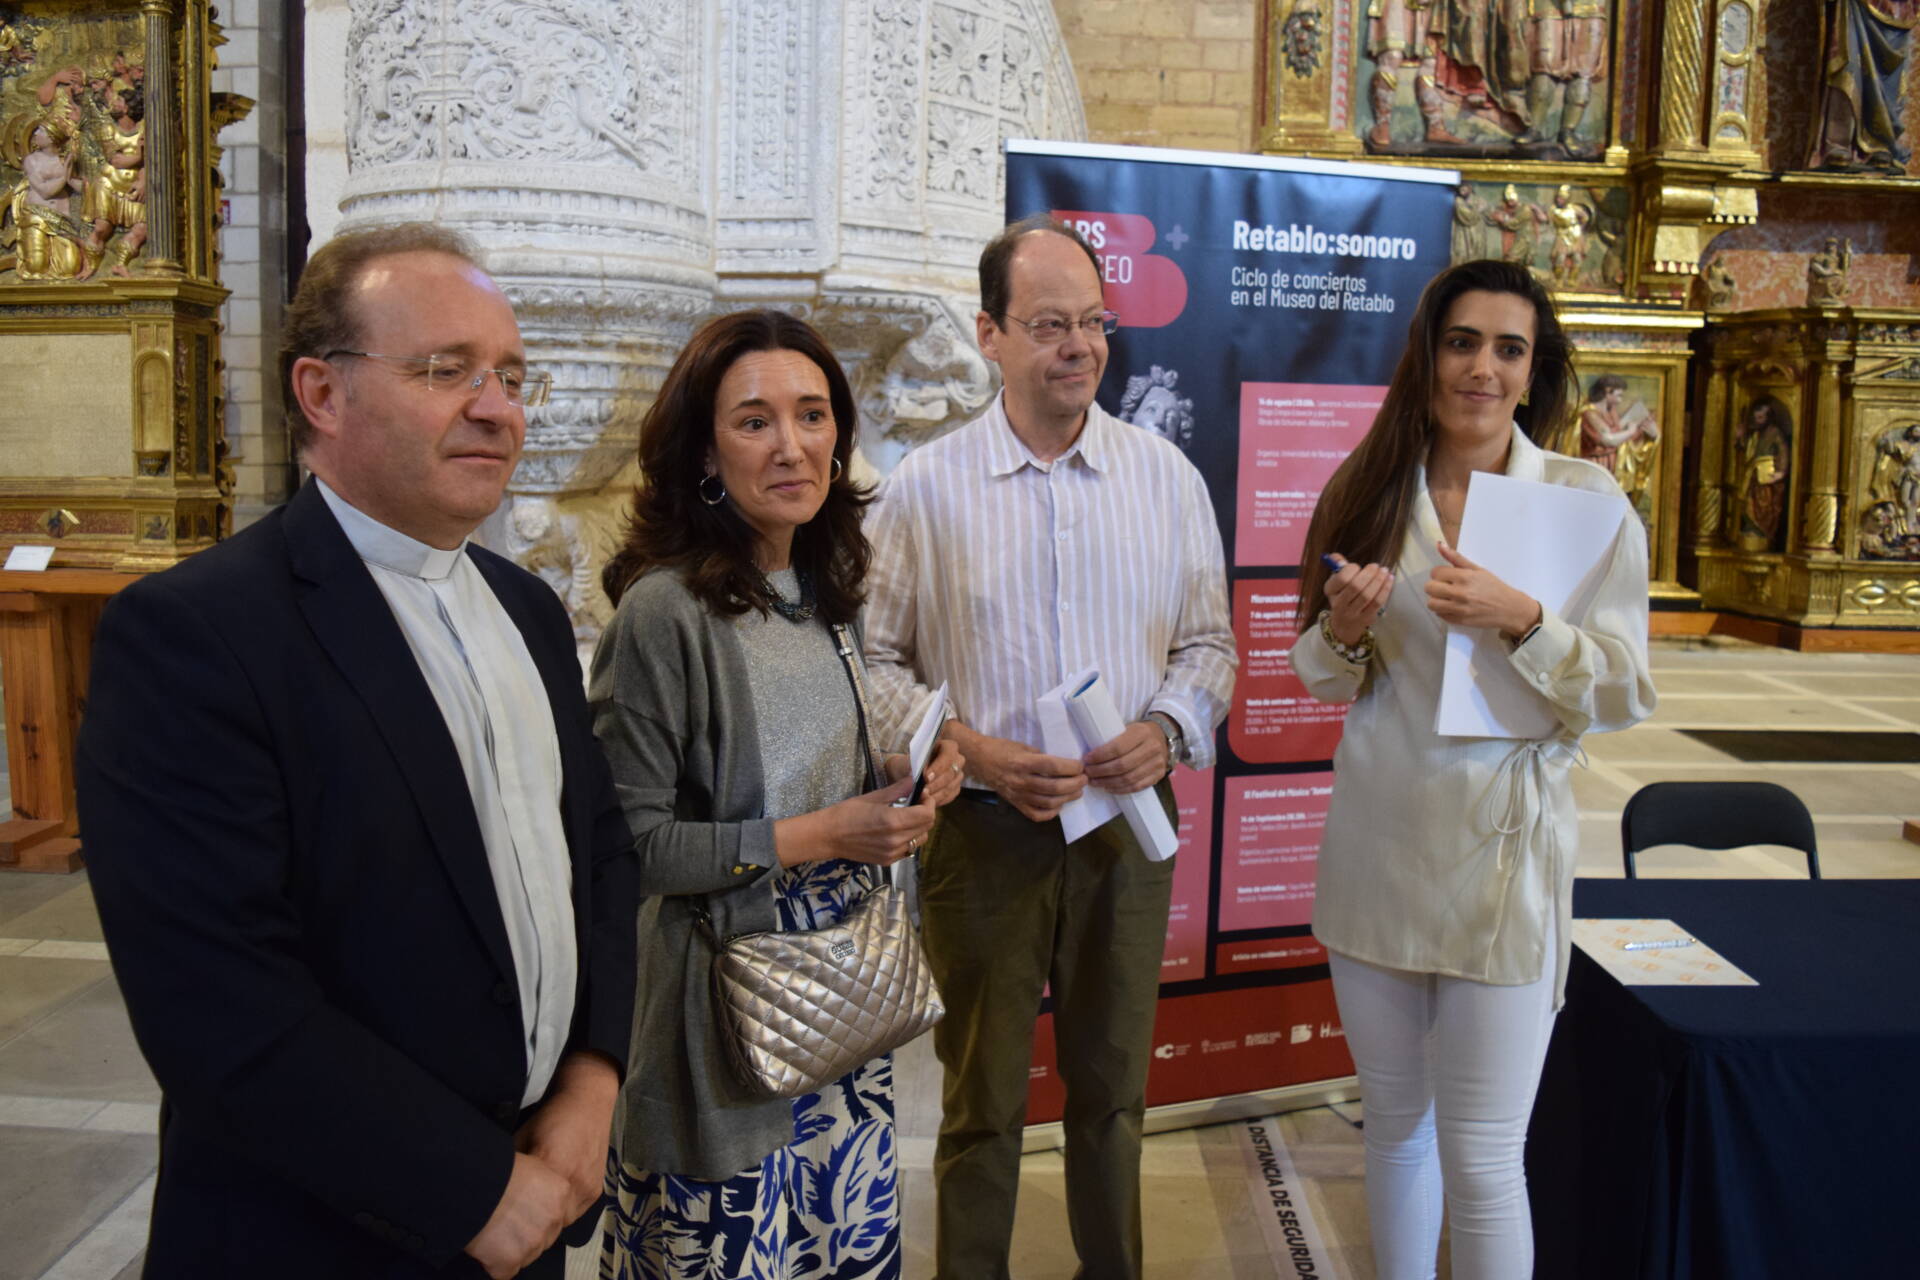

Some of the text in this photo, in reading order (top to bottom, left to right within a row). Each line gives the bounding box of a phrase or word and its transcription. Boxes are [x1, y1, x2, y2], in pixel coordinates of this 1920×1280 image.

[1233, 220, 1416, 260] Retablo:sonoro
[1231, 266, 1367, 293] Ciclo de conciertos
[1231, 288, 1395, 313] en el Museo del Retablo
[1249, 1126, 1284, 1188] DISTANCIA
[1270, 1190, 1293, 1208] DE
